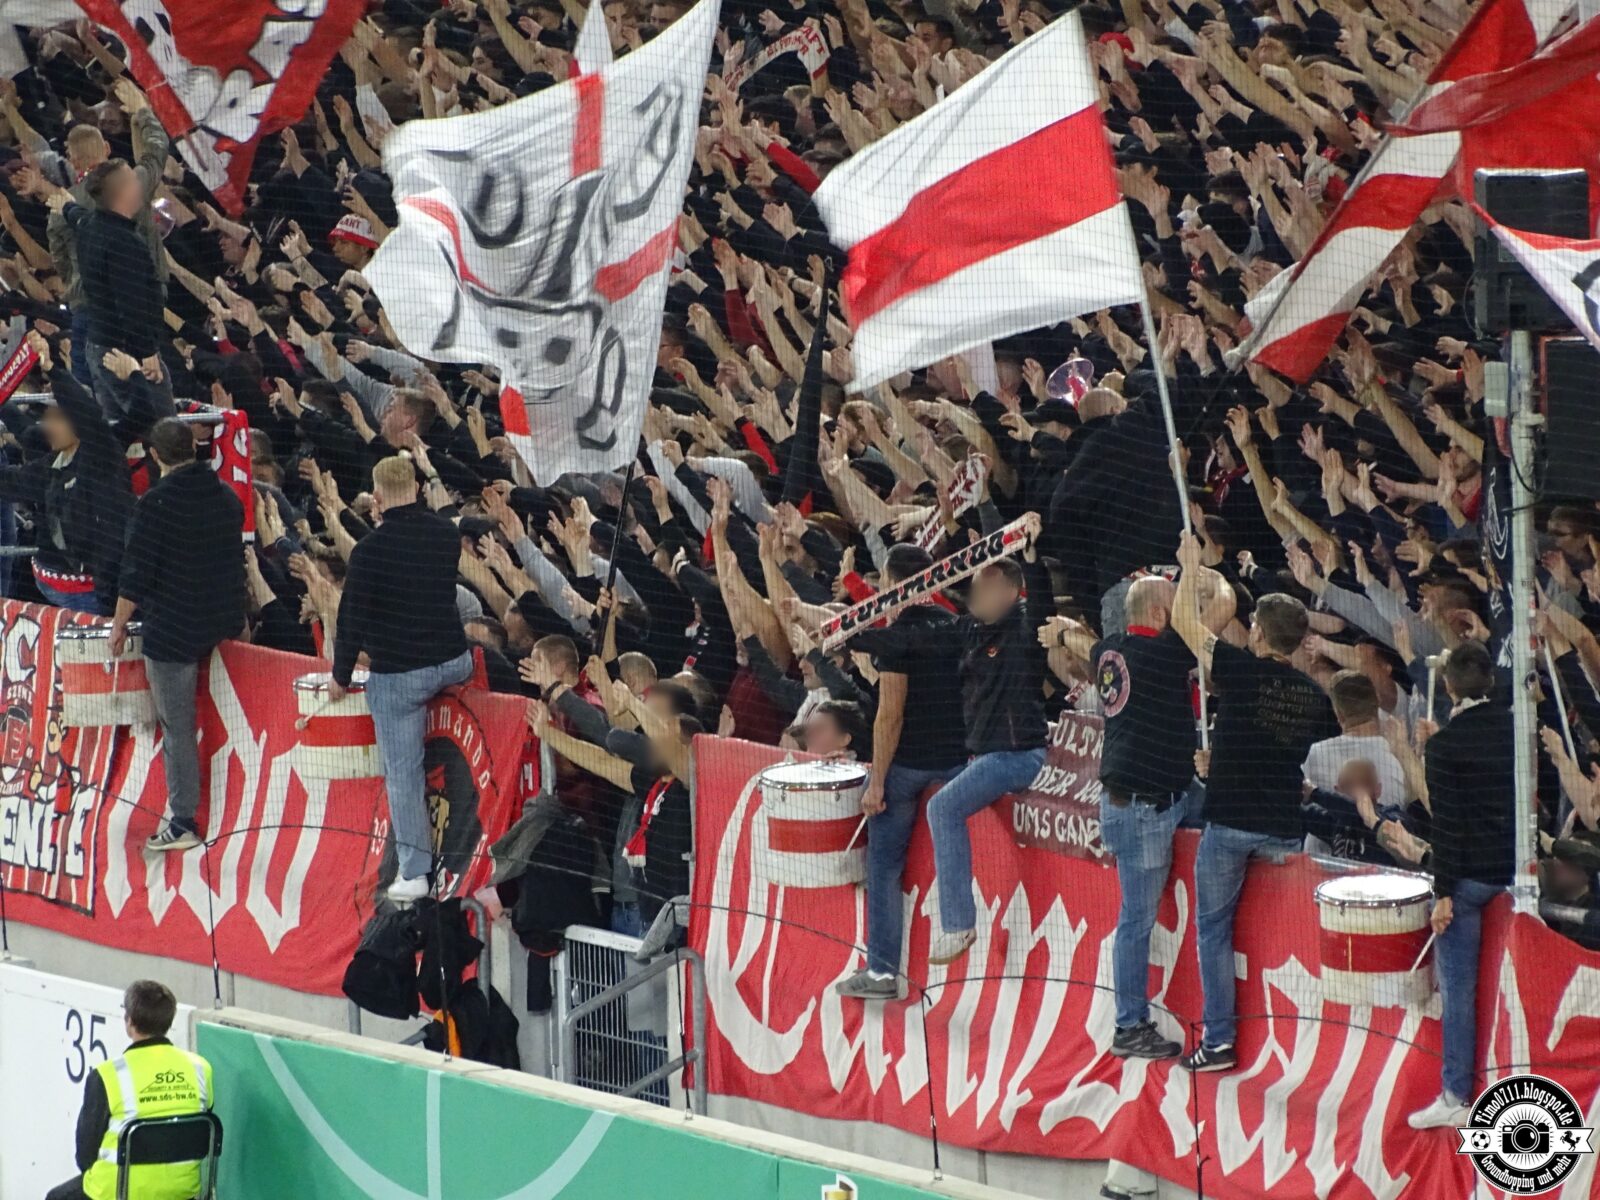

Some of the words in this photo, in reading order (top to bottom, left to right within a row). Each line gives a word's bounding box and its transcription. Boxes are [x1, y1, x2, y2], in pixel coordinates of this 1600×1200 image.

[1029, 764, 1077, 797] DER
[1013, 802, 1051, 840] UMS
[66, 1009, 108, 1083] 35
[154, 1072, 185, 1084] SDS
